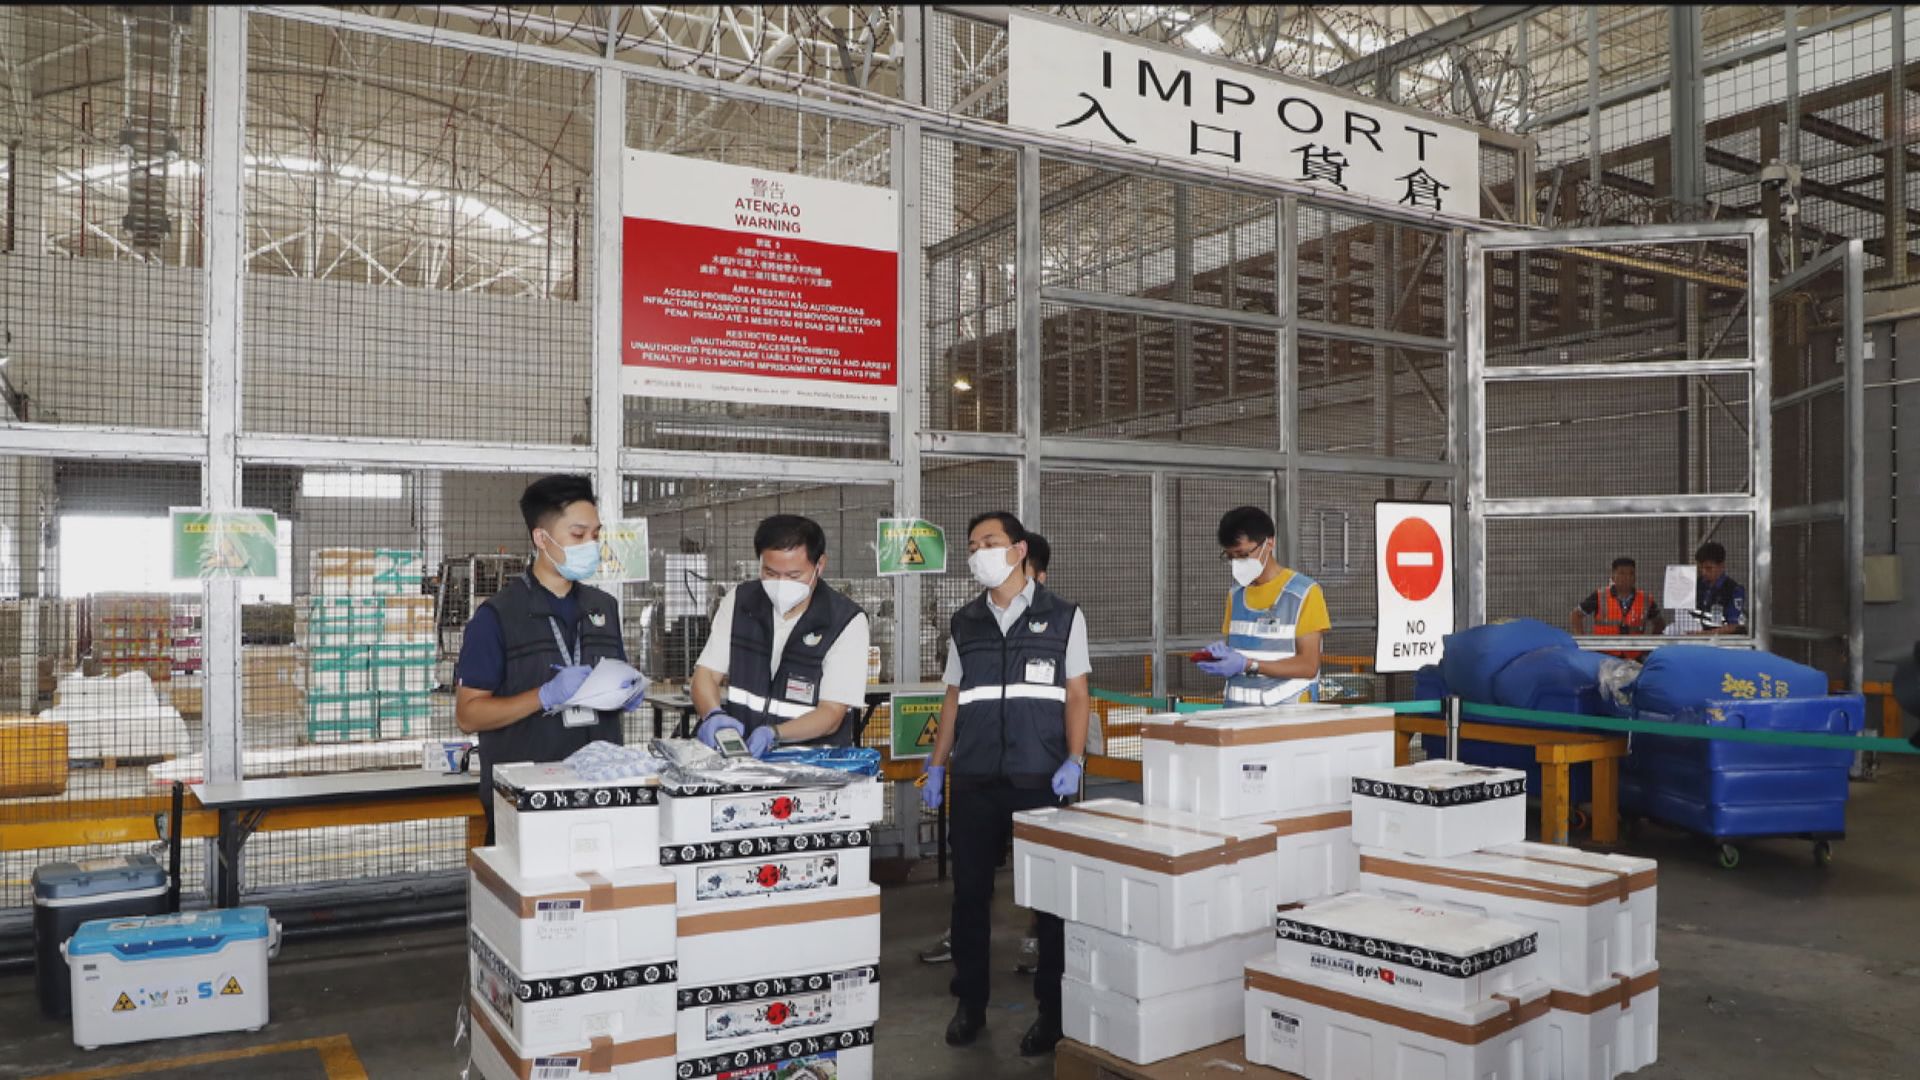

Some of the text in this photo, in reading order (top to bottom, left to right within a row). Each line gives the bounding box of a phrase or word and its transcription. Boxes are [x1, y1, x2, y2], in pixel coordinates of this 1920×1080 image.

[1102, 50, 1438, 161] IMPORT
[1056, 92, 1450, 211] 入口貨倉
[750, 178, 785, 200] 警告
[735, 198, 801, 217] ATENÇÃO
[735, 213, 801, 233] WARNING
[643, 295, 704, 309] INFRACTORES
[750, 307, 761, 315] DE
[764, 308, 791, 317] SEREM
[794, 311, 839, 322] REMOVIDOS
[848, 317, 881, 327] DETIDOS
[664, 288, 699, 299] ACESSO
[701, 291, 741, 303] PROIBIDO
[751, 298, 789, 308] PESSOAS
[791, 300, 808, 310] NÃO
[810, 304, 864, 315] AUTORIZADAS
[693, 310, 725, 321] PRISÃO
[727, 313, 742, 323] ATÉ
[751, 316, 779, 326] MESES
[781, 319, 792, 327] OU
[805, 322, 824, 331] DIAS
[838, 325, 864, 335] MULTA
[690, 336, 840, 357] UNAUTHORIZED ACCESS PROHIBITED
[726, 329, 777, 340] RESTRICTED
[779, 334, 800, 343] AREA
[630, 340, 890, 371] UNAUTHORIZED PERSONS ARE LIABLE TO REMOVAL AND ARREST
[686, 356, 698, 365] UP
[700, 357, 711, 365] TO
[720, 358, 755, 369] MONTHS
[757, 360, 817, 374] IMPRISONMENT
[819, 366, 831, 375] OR
[843, 368, 863, 377] DAYS
[865, 370, 881, 379] FINE
[1406, 619, 1425, 635] NO
[1393, 640, 1436, 657] ENTRY
[177, 996, 188, 1005] 23
